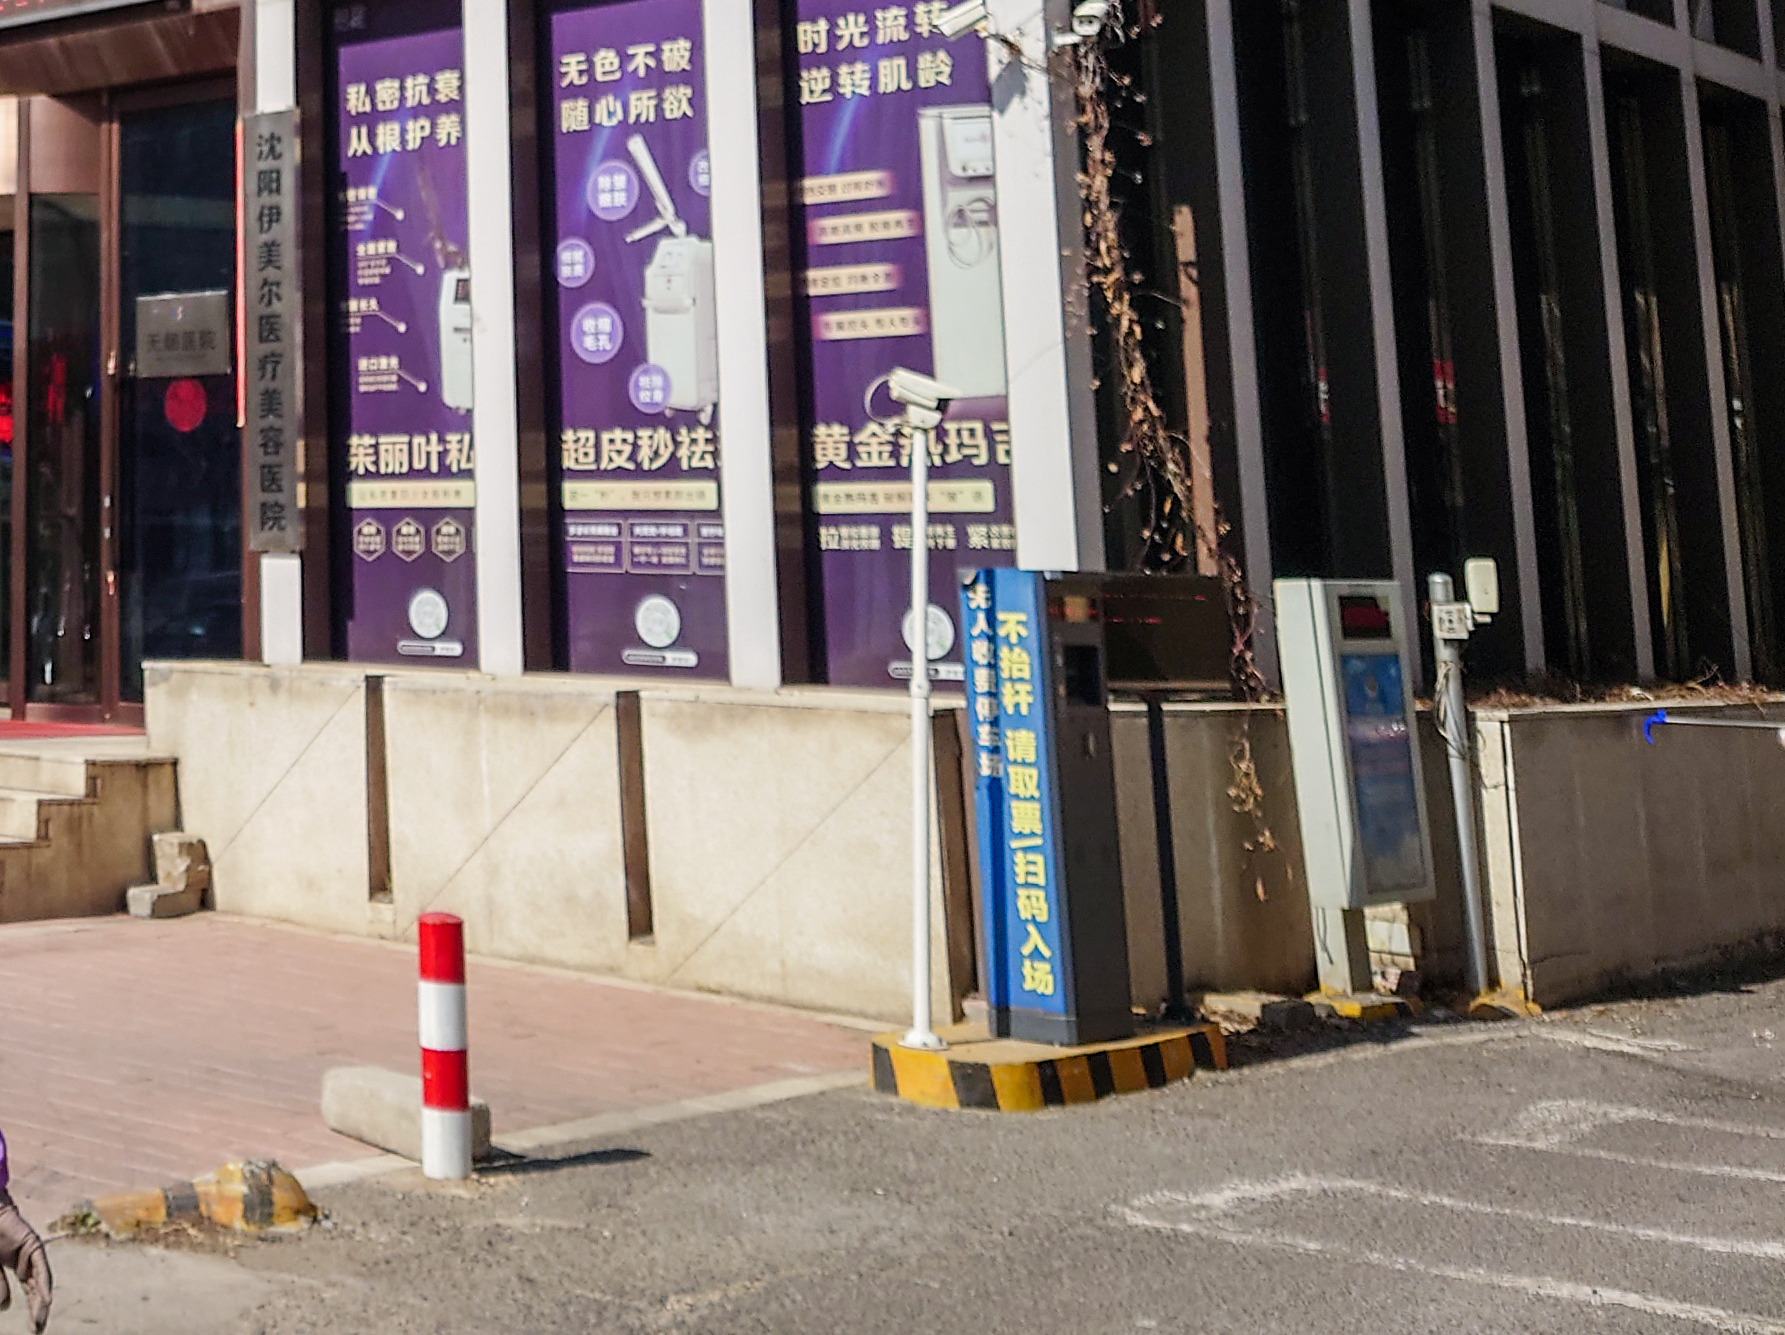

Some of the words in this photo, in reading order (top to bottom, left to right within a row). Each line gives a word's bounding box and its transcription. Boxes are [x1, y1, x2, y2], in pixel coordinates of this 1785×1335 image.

[346, 69, 461, 116] 私密抗衰
[799, 48, 954, 105] 逆转肌龄
[560, 83, 694, 134] 随心所欲
[347, 113, 463, 158] 从根护养
[255, 132, 286, 533] 沈阳伊美尔医疗美容医院
